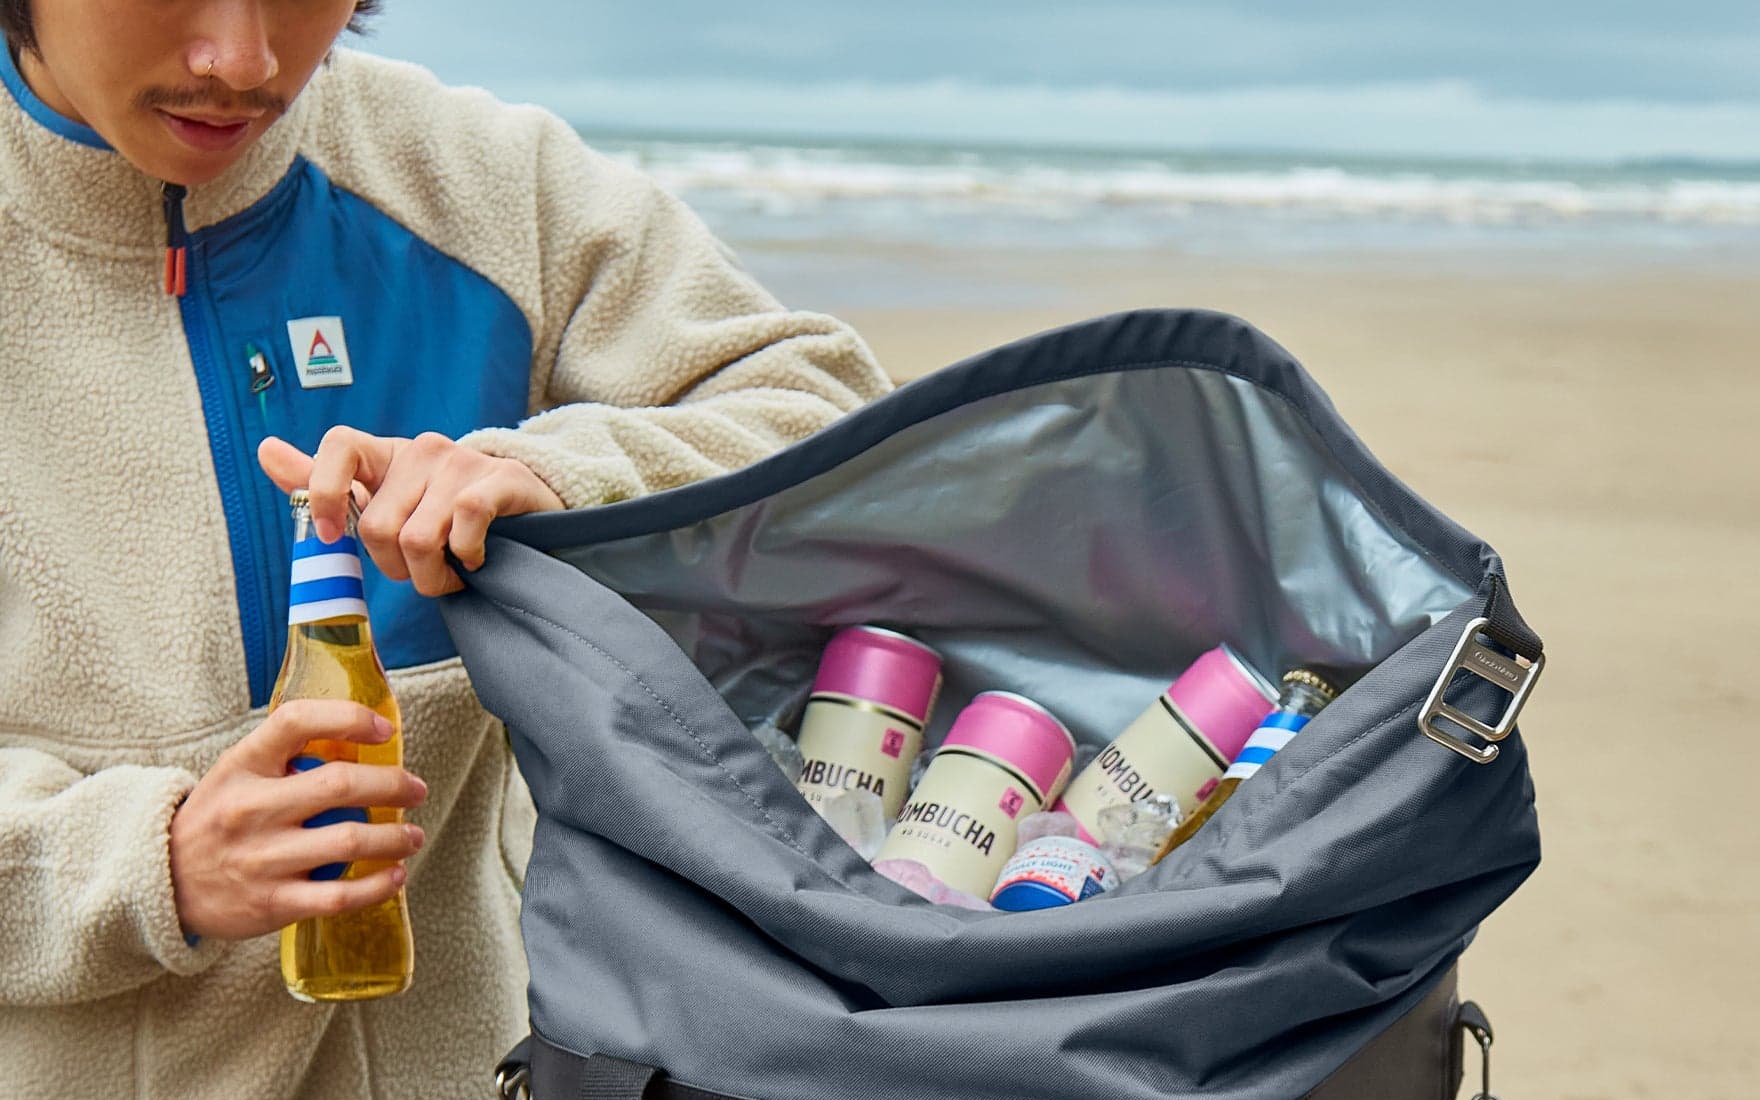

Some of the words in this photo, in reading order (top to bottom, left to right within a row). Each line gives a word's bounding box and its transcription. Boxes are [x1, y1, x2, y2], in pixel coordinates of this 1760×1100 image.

[798, 758, 884, 798] MBUCHA
[1099, 745, 1153, 802] KOMBU
[897, 801, 995, 856] OMBUCHA
